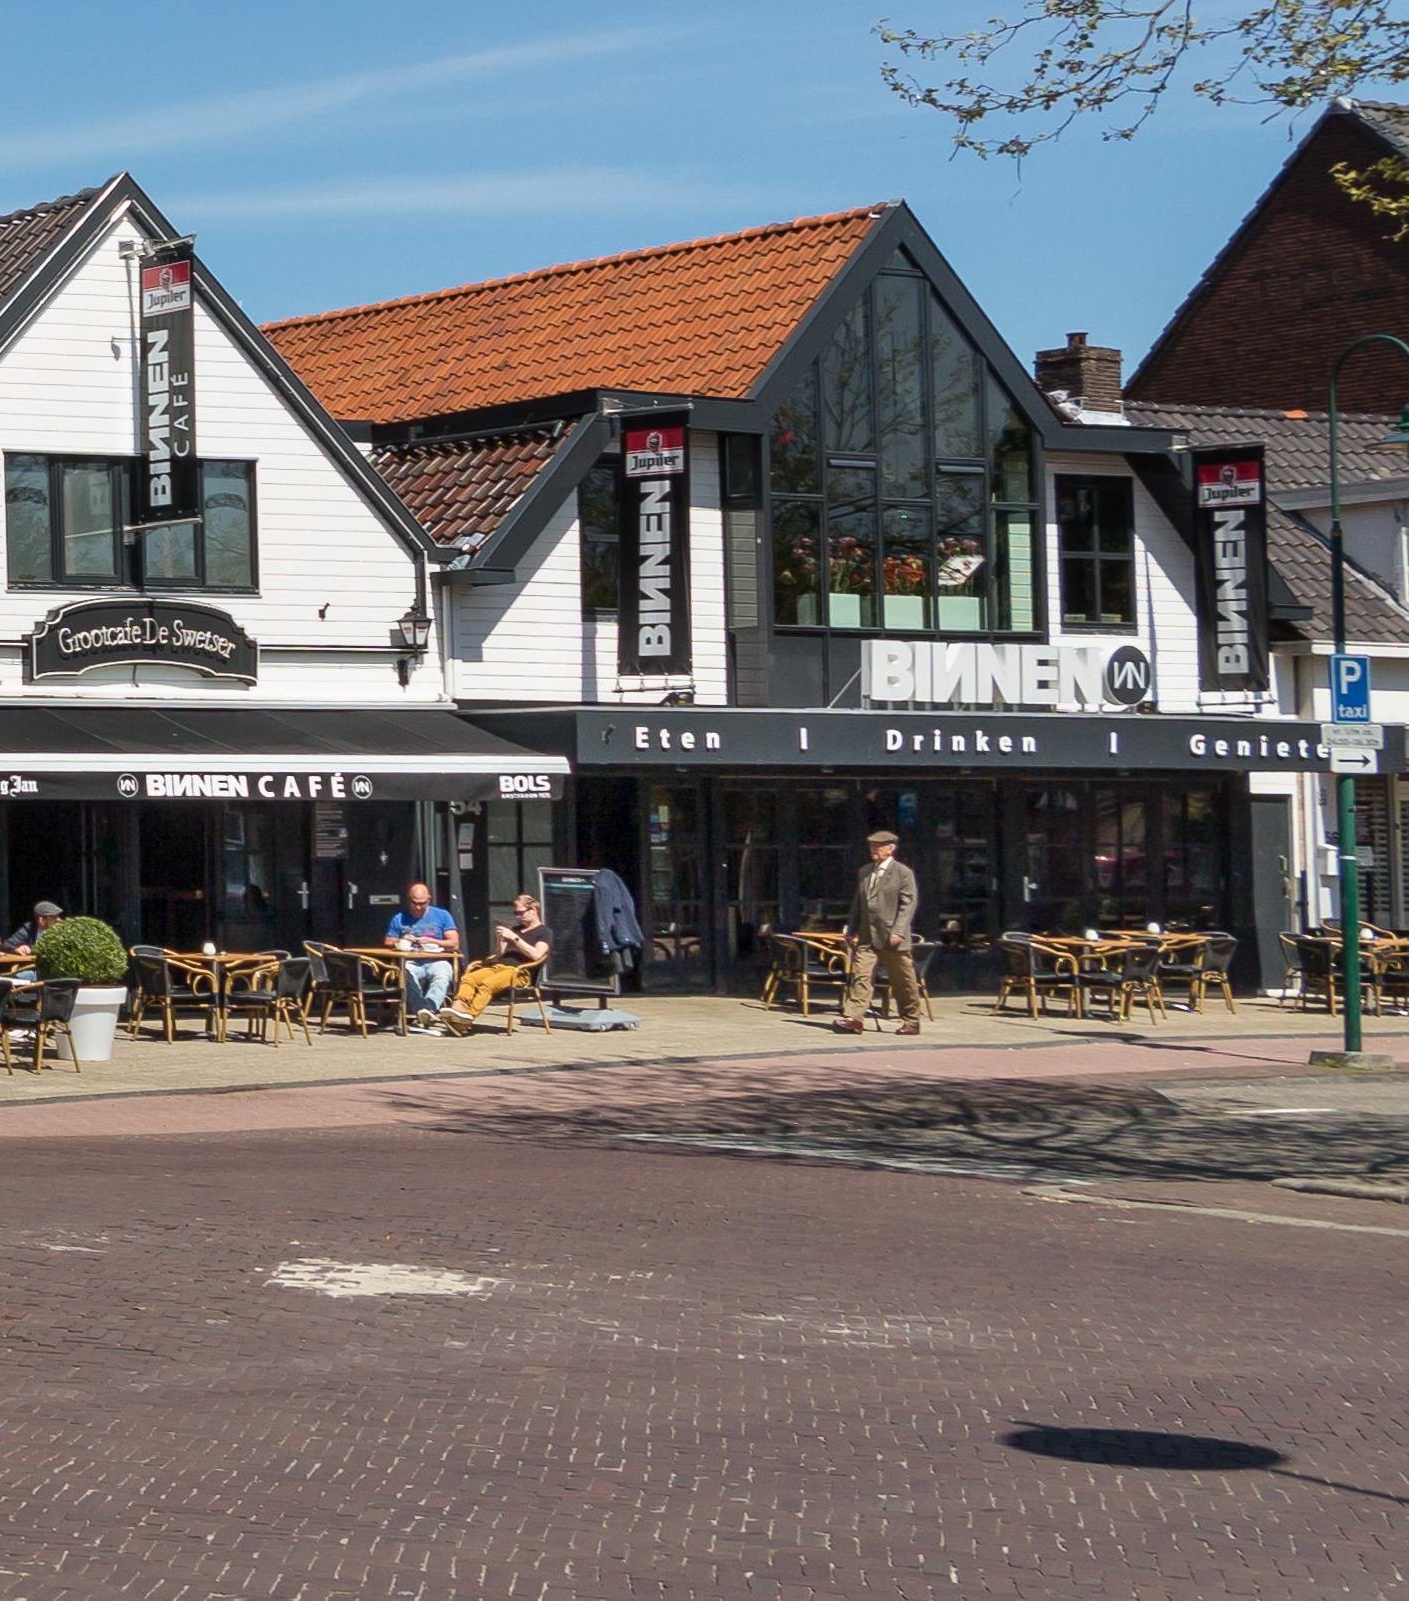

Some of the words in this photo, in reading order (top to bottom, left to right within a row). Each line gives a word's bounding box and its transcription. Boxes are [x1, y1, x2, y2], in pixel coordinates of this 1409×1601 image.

[147, 290, 186, 310] Jupiler
[170, 371, 190, 458] CAFÉ
[630, 453, 680, 471] Jupiler
[1203, 485, 1255, 502] Jupiler
[143, 617, 169, 645] De
[173, 619, 236, 659] Swetser
[1340, 660, 1361, 694] P
[1338, 703, 1368, 719] taxi
[635, 726, 721, 749] Eten
[886, 729, 1037, 753] Drinken
[1189, 734, 1330, 759] Geniete
[10, 775, 39, 798] Jan
[258, 772, 346, 798] CAFÉ
[499, 775, 551, 792] BOLS
